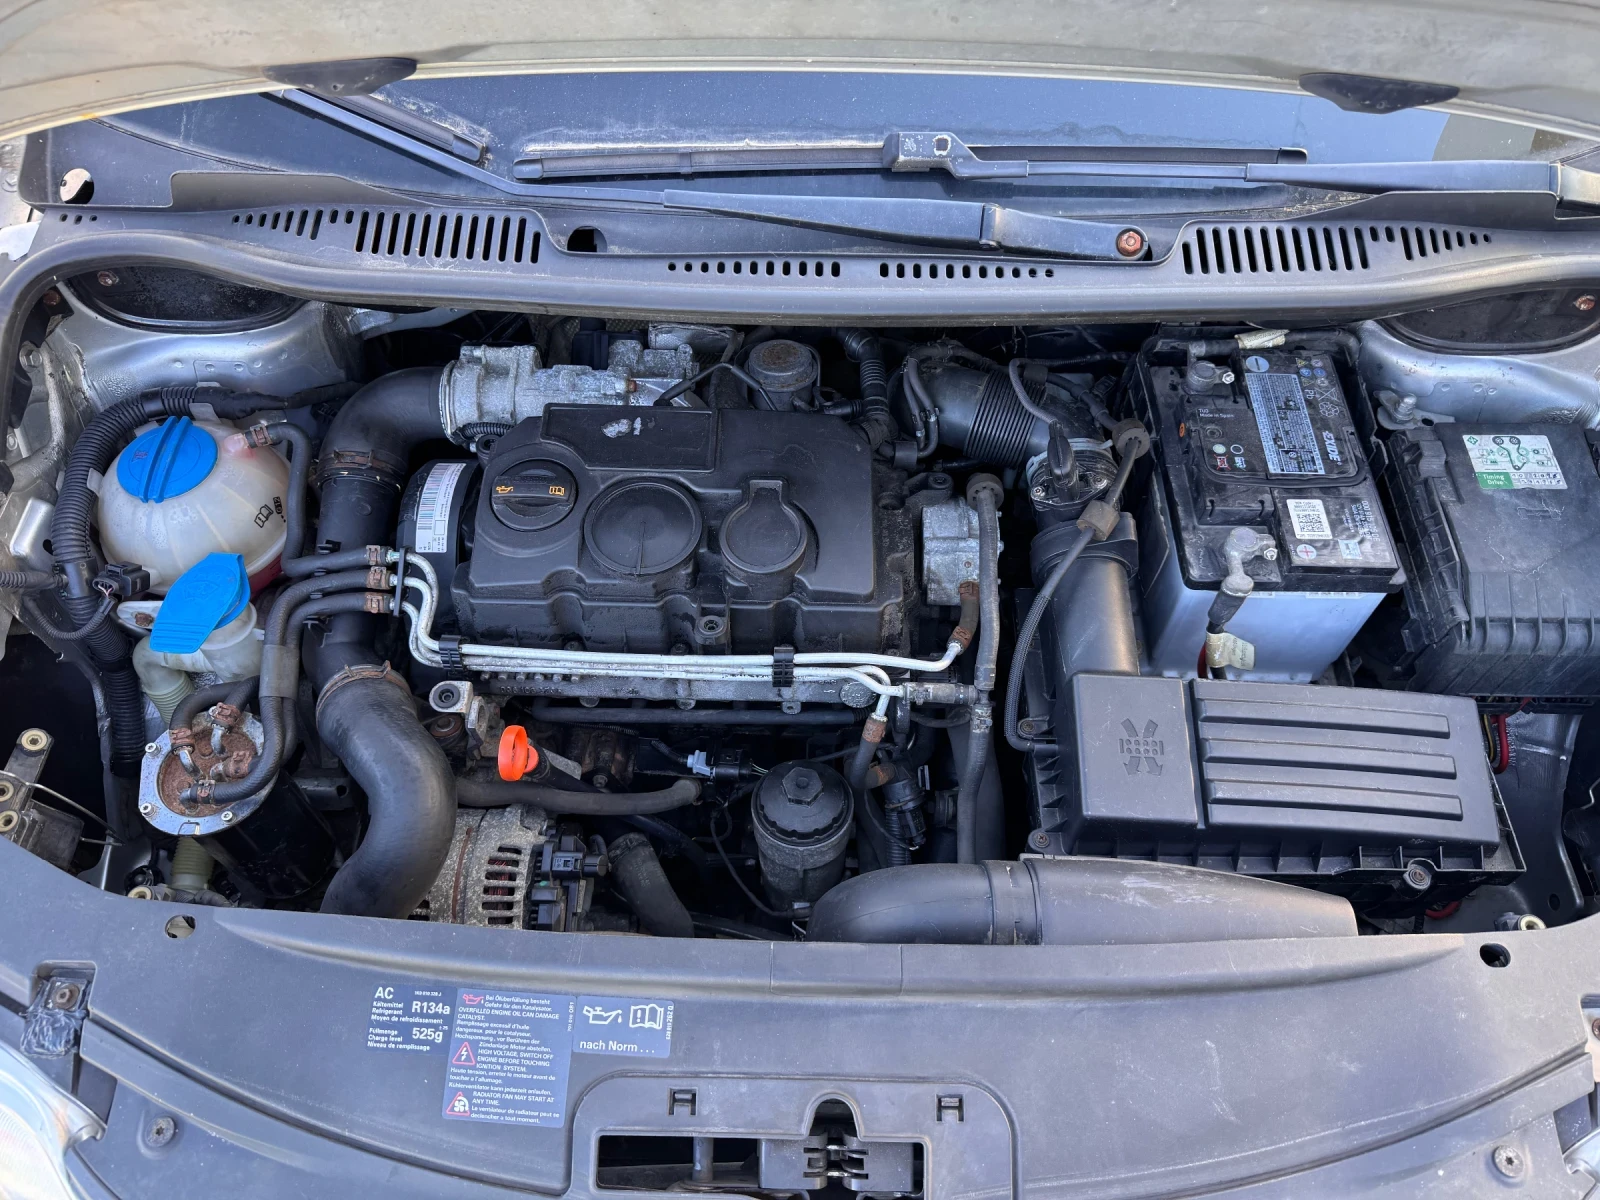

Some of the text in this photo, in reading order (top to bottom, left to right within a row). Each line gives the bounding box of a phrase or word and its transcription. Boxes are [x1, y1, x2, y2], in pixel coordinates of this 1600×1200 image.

[1304, 390, 1315, 399] Pb
[1322, 430, 1340, 461] EXIDE
[375, 987, 394, 999] AC
[495, 995, 529, 1004] Ölüberfüllung
[412, 1001, 450, 1014] R134a
[412, 1027, 443, 1043] 525g
[580, 1040, 605, 1050] nach
[608, 1041, 637, 1052] Norm
